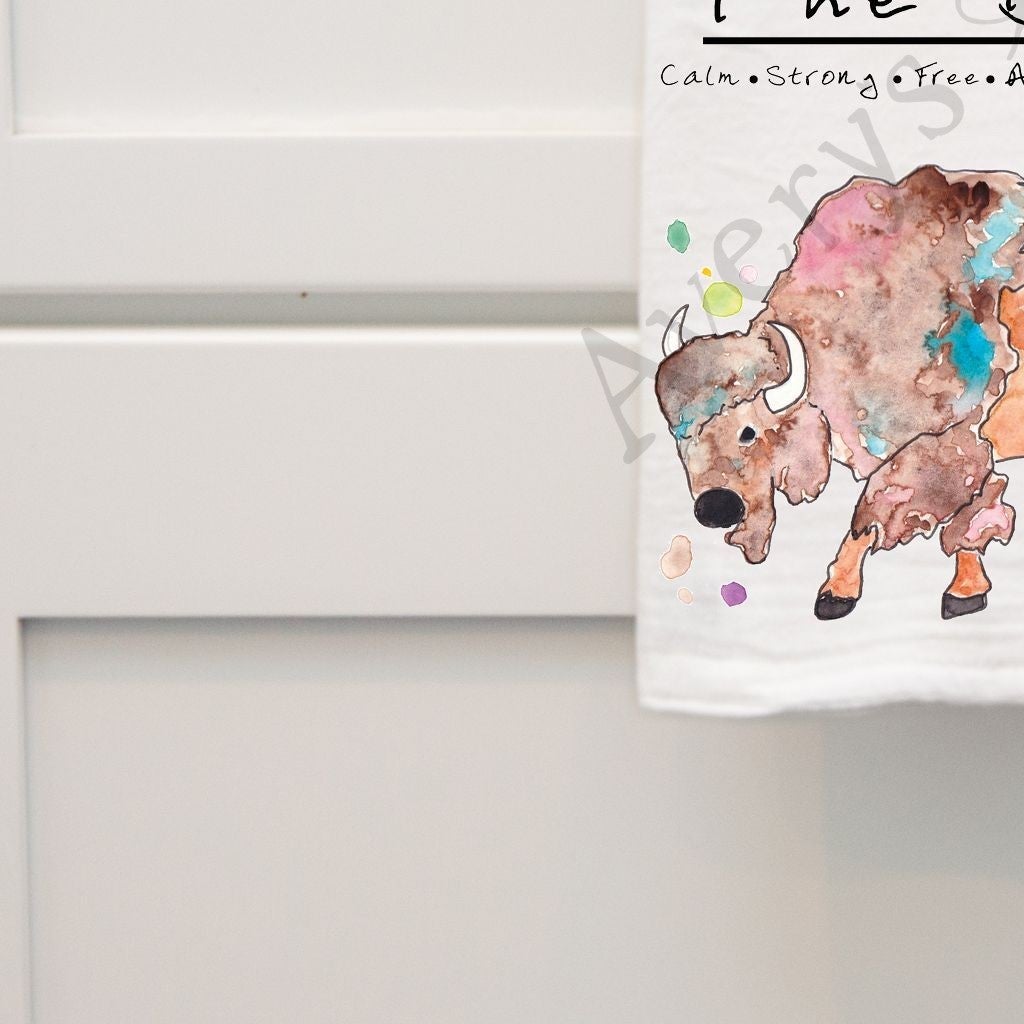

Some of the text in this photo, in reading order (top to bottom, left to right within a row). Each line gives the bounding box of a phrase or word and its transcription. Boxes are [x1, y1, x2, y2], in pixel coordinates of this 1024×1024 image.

[660, 63, 740, 86] Calm
[766, 65, 879, 100] Strong
[914, 61, 979, 88] Free
